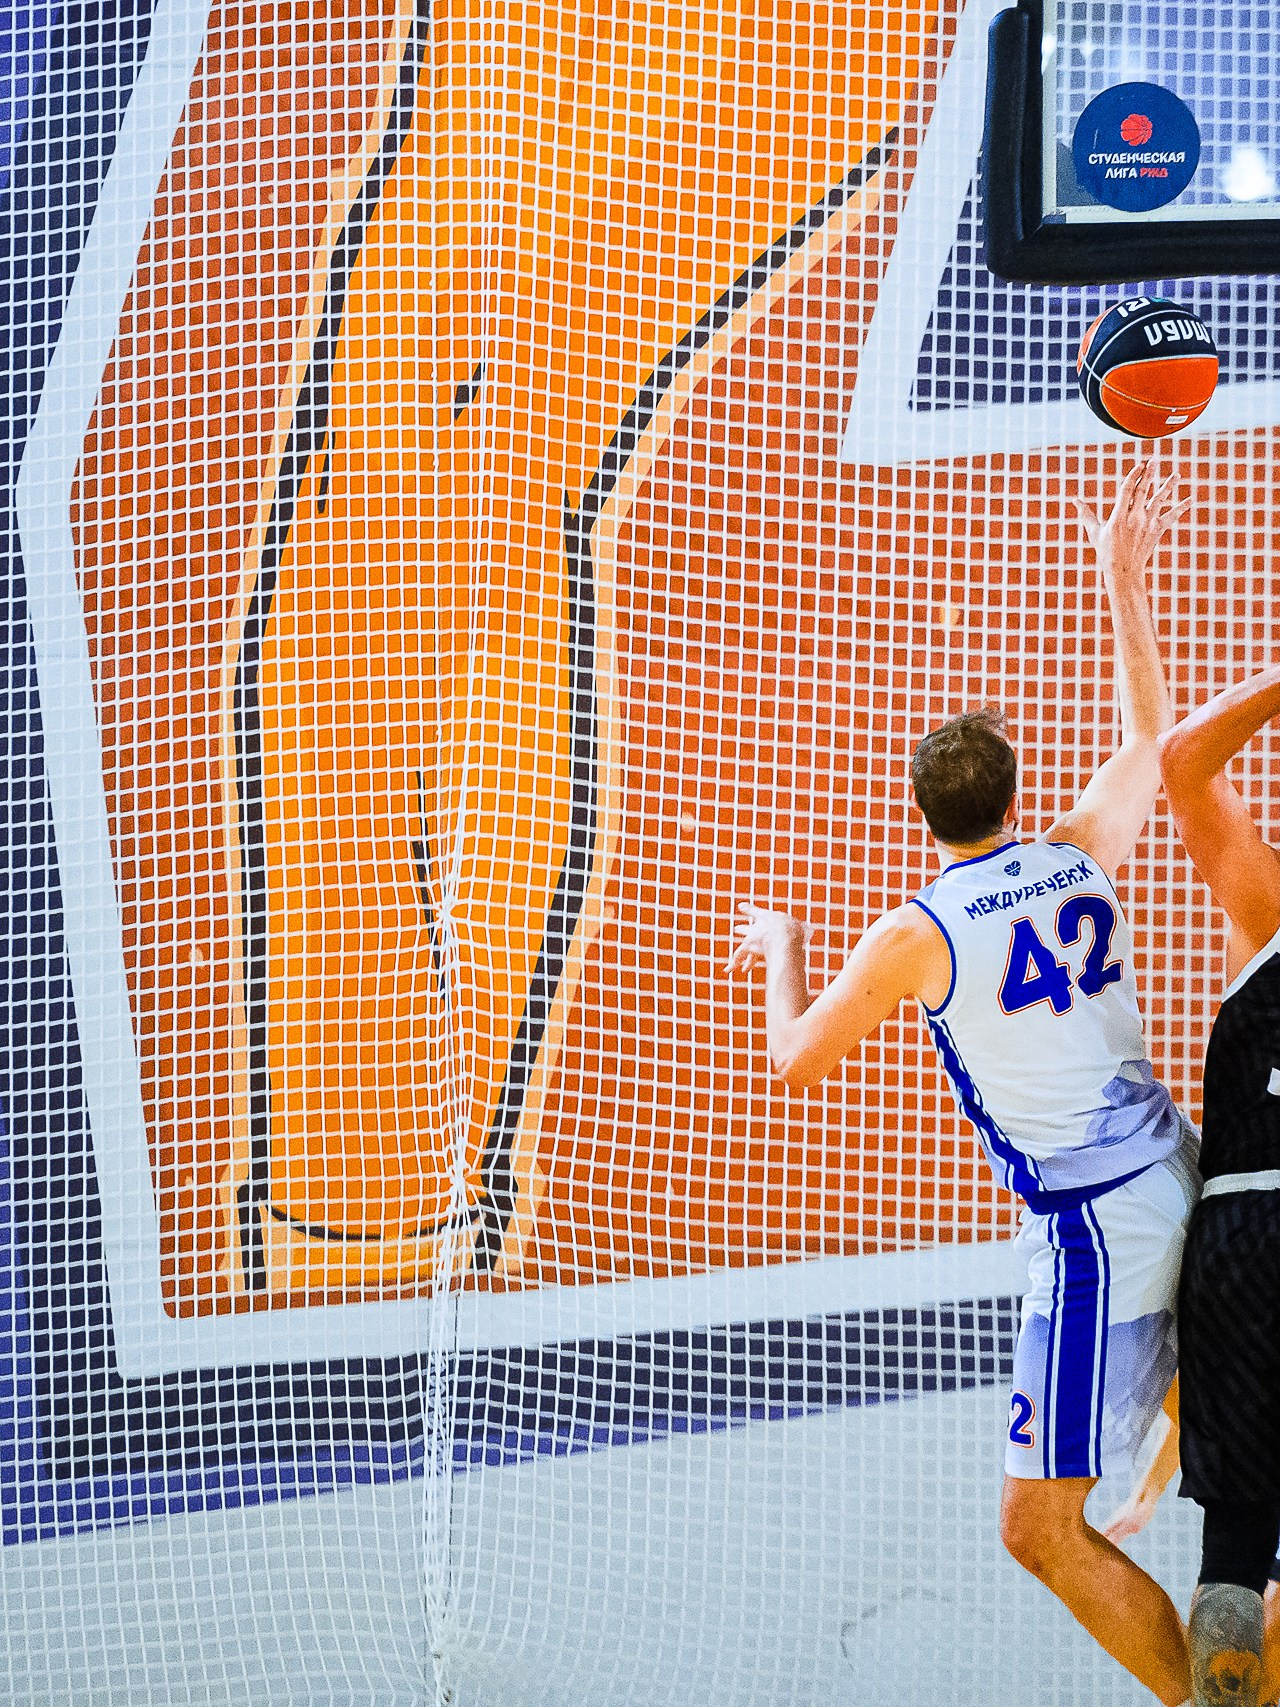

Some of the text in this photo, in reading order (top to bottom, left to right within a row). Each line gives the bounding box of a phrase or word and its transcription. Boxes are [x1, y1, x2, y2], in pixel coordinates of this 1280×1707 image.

[1088, 152, 1186, 165] СТУДЕНЧЕСКАЯ
[1105, 167, 1168, 179] ЛИГА РЖД
[997, 893, 1124, 1017] 42
[1007, 1390, 1037, 1449] 2
